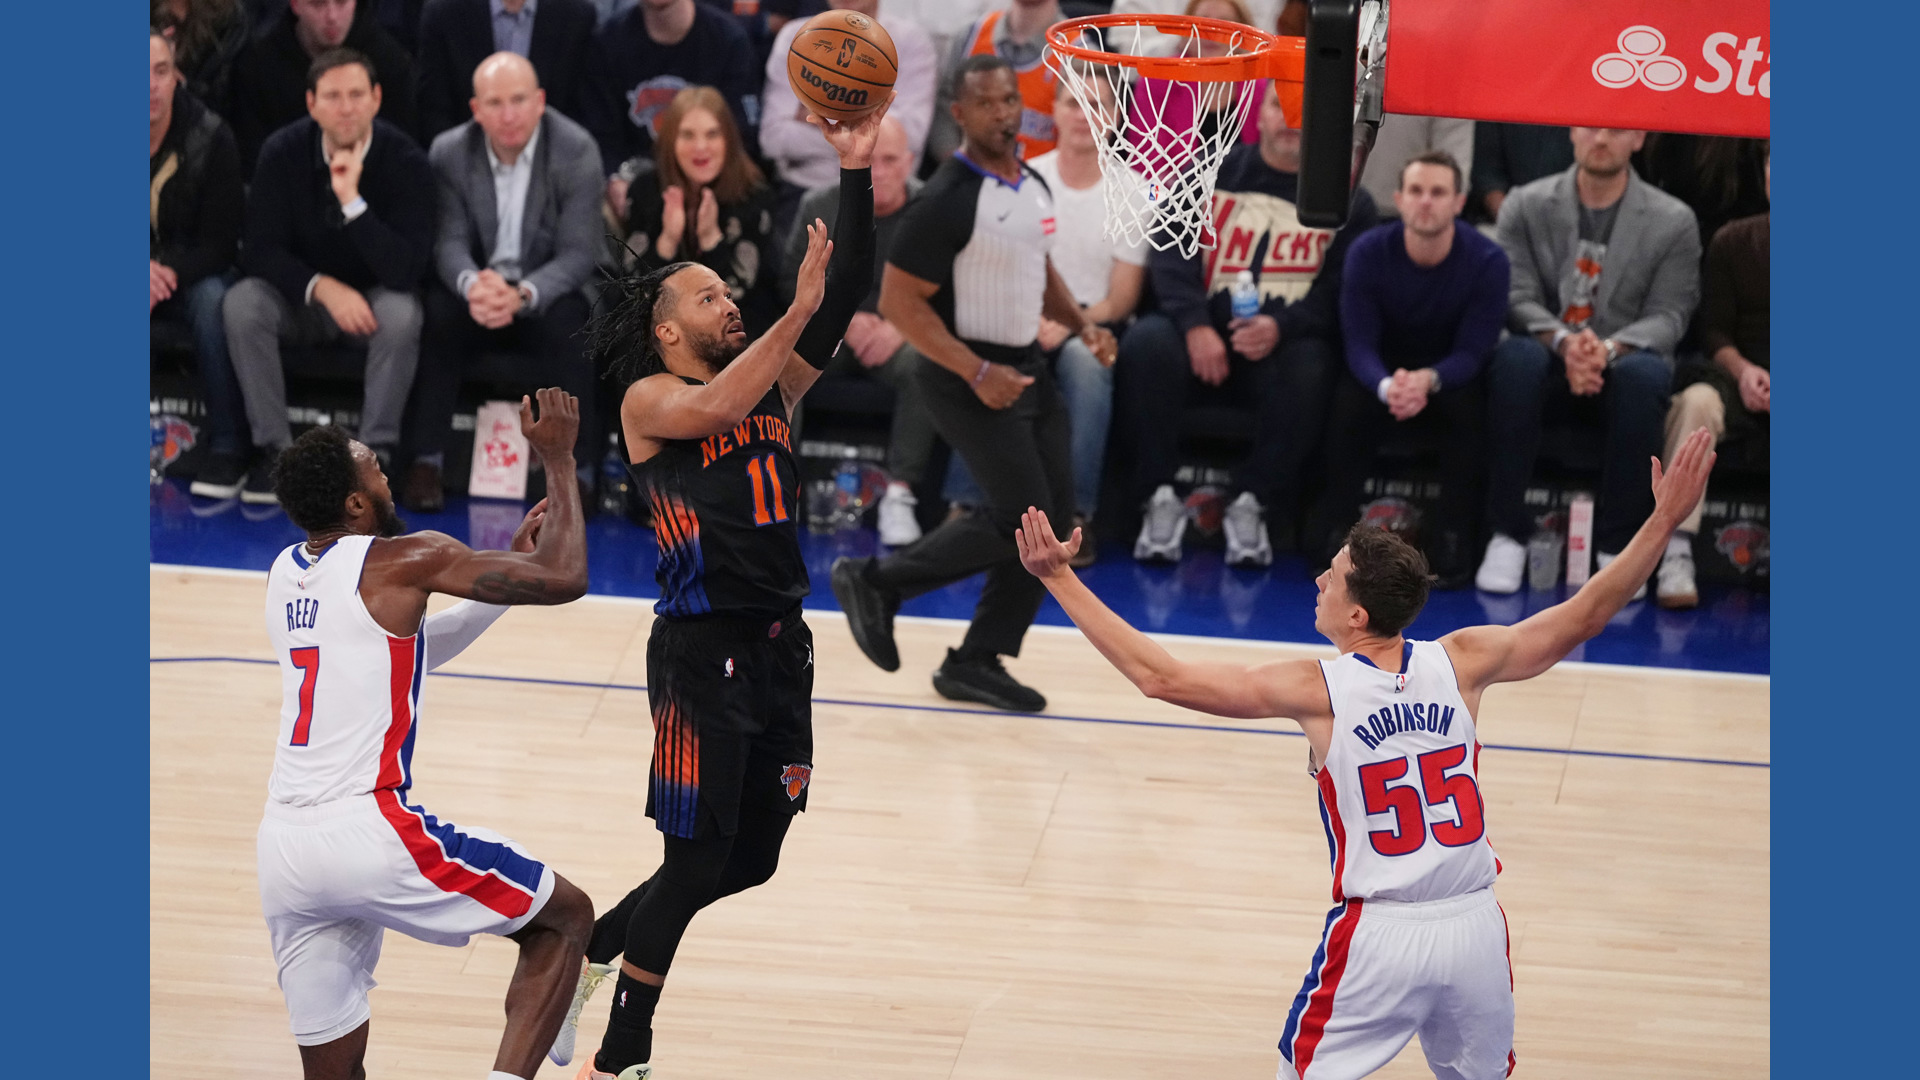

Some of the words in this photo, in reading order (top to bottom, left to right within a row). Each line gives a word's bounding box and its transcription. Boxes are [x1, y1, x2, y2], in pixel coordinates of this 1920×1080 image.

[801, 65, 869, 106] Wilson
[700, 417, 751, 470] NEW
[753, 415, 793, 454] YORK
[745, 452, 790, 527] 11
[286, 598, 319, 632] REED
[289, 646, 320, 747] 7
[1352, 702, 1456, 750] ROBINSON
[1357, 742, 1485, 857] 55
